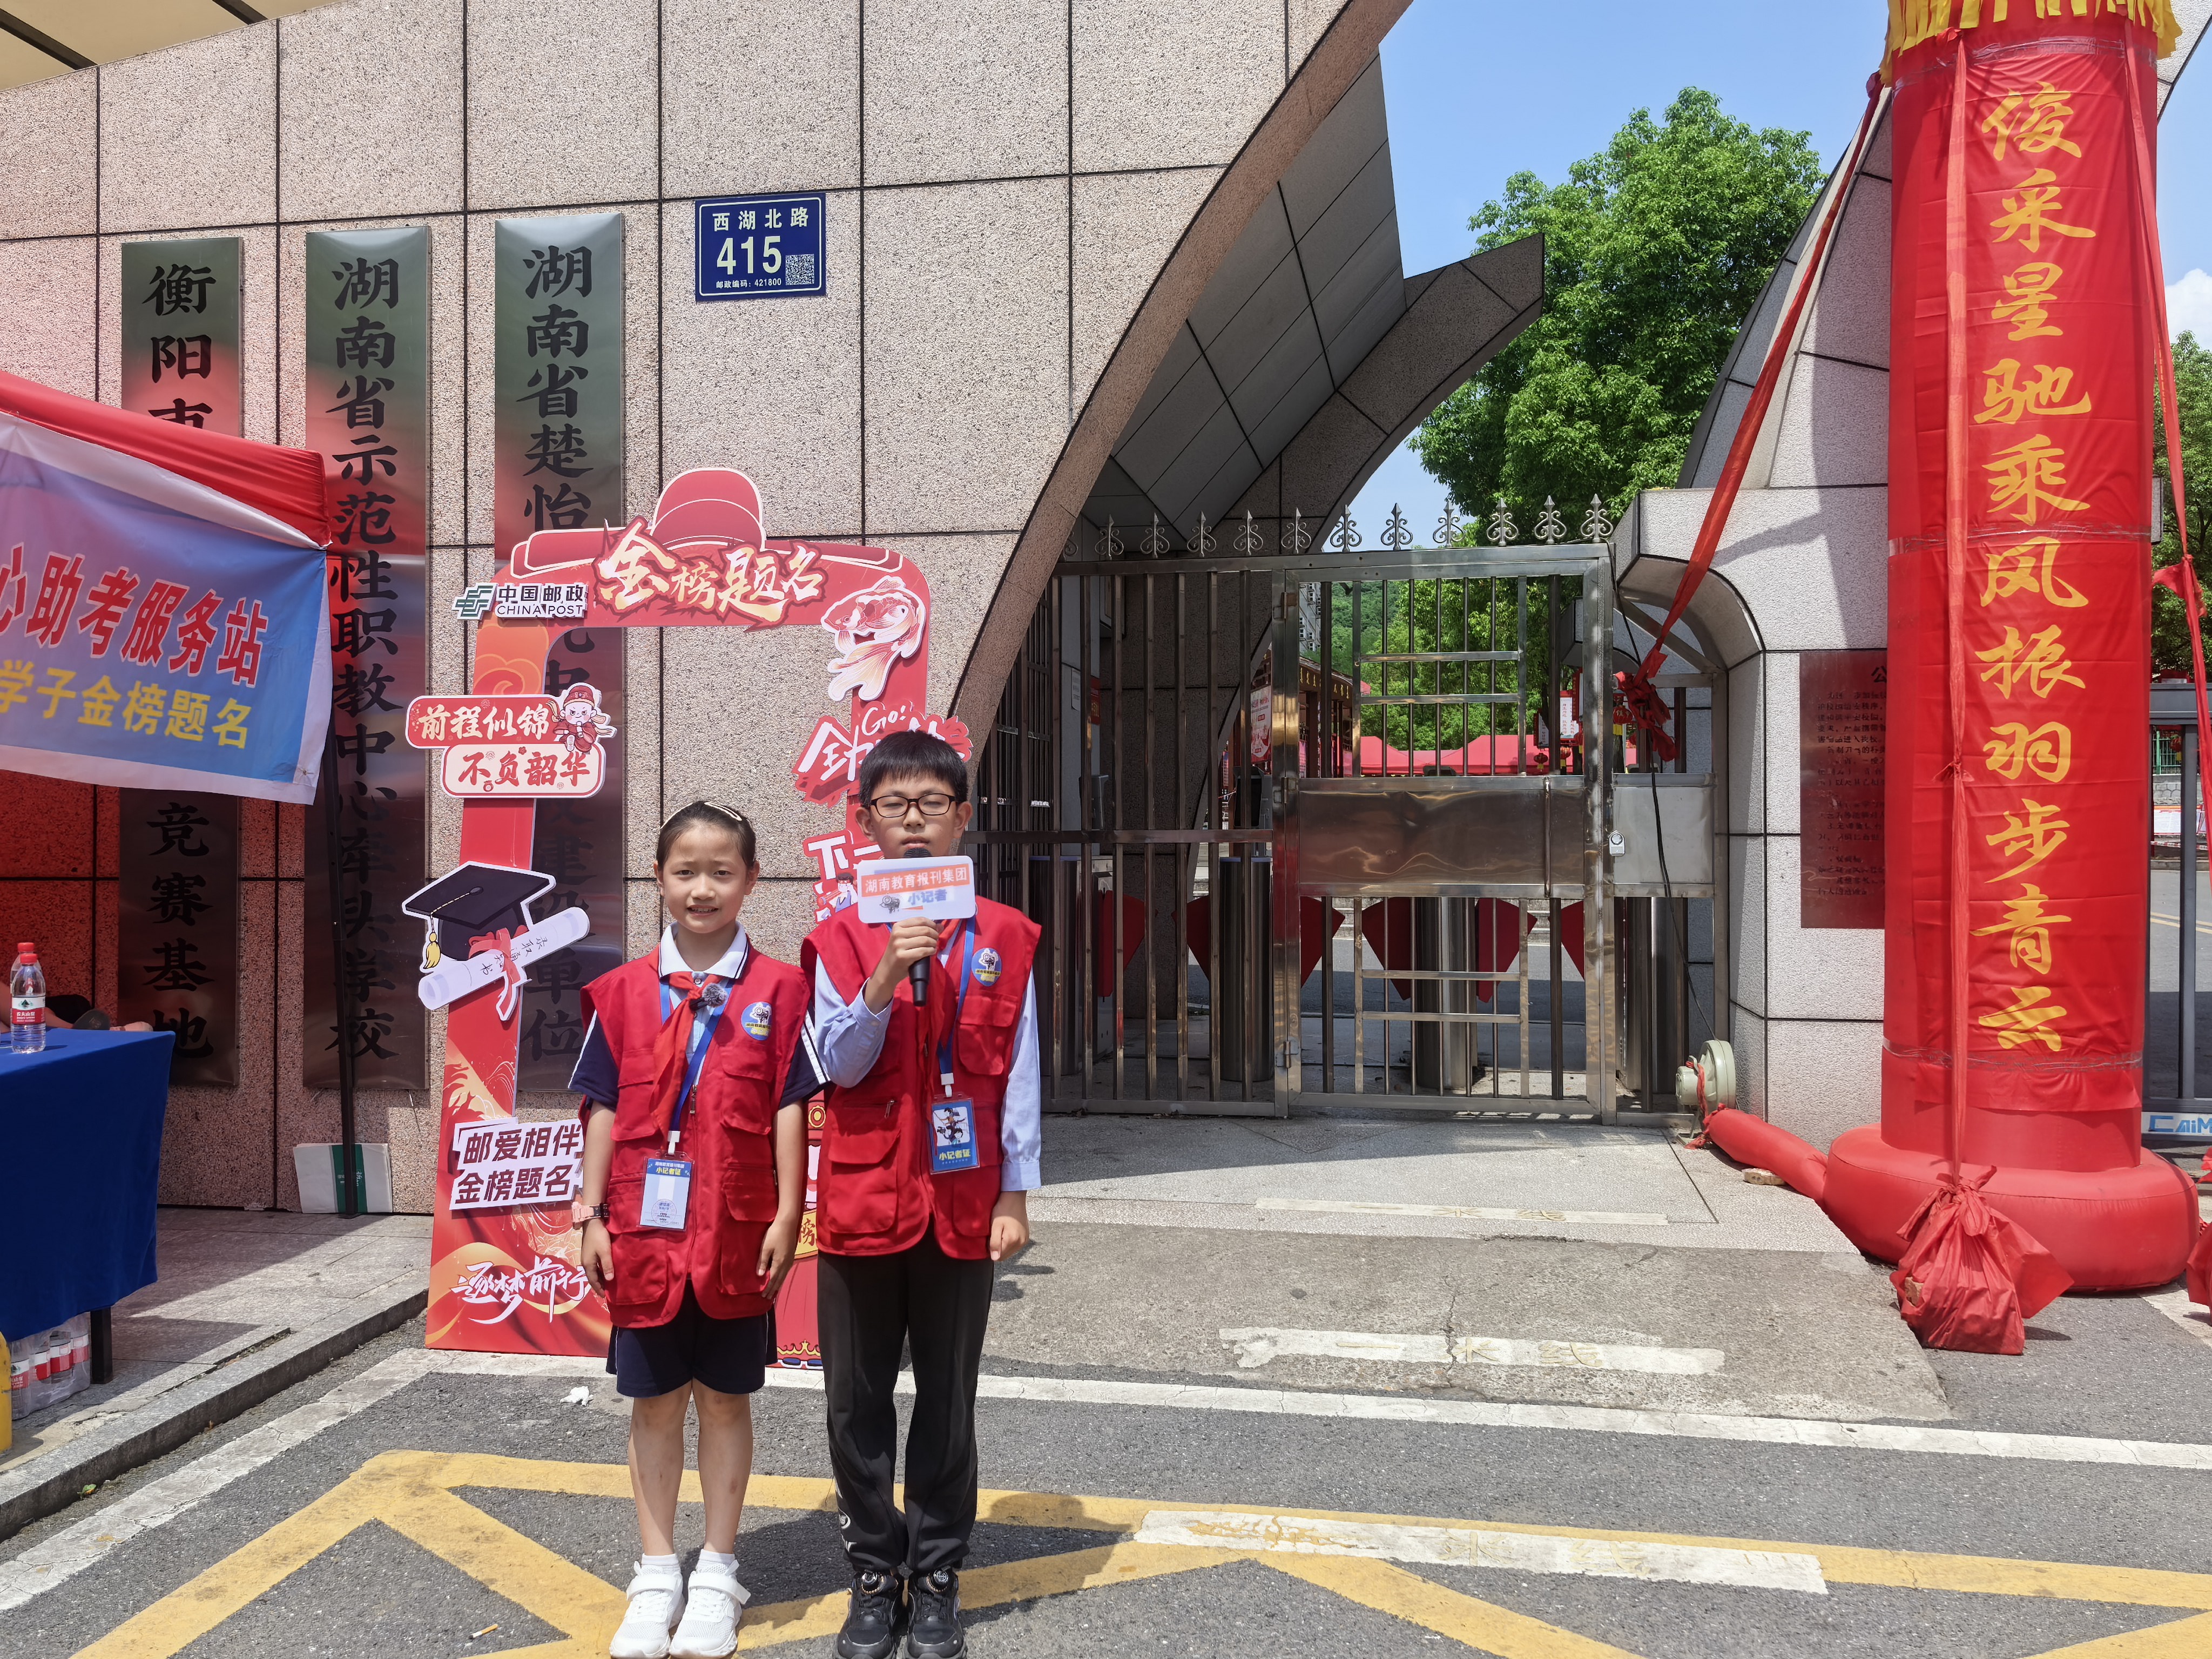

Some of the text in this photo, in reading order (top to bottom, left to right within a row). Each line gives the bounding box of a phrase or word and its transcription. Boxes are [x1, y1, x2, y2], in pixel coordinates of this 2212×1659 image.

[712, 207, 808, 232] 西湖北路
[717, 235, 782, 275] 415
[598, 522, 823, 622] 金榜题名
[497, 605, 583, 615] CHINA POST
[498, 585, 583, 602] 中国邮政
[0, 659, 252, 750] 学子金榜题名
[419, 703, 550, 740] 前程似锦
[458, 751, 590, 787] 不负韶华
[865, 867, 967, 893] 湖南教育报刊集团
[908, 889, 947, 906] 小记者
[463, 1124, 582, 1164] 邮爱相伴
[939, 1149, 970, 1161] 小记者证
[455, 1164, 573, 1204] 金榜题名
